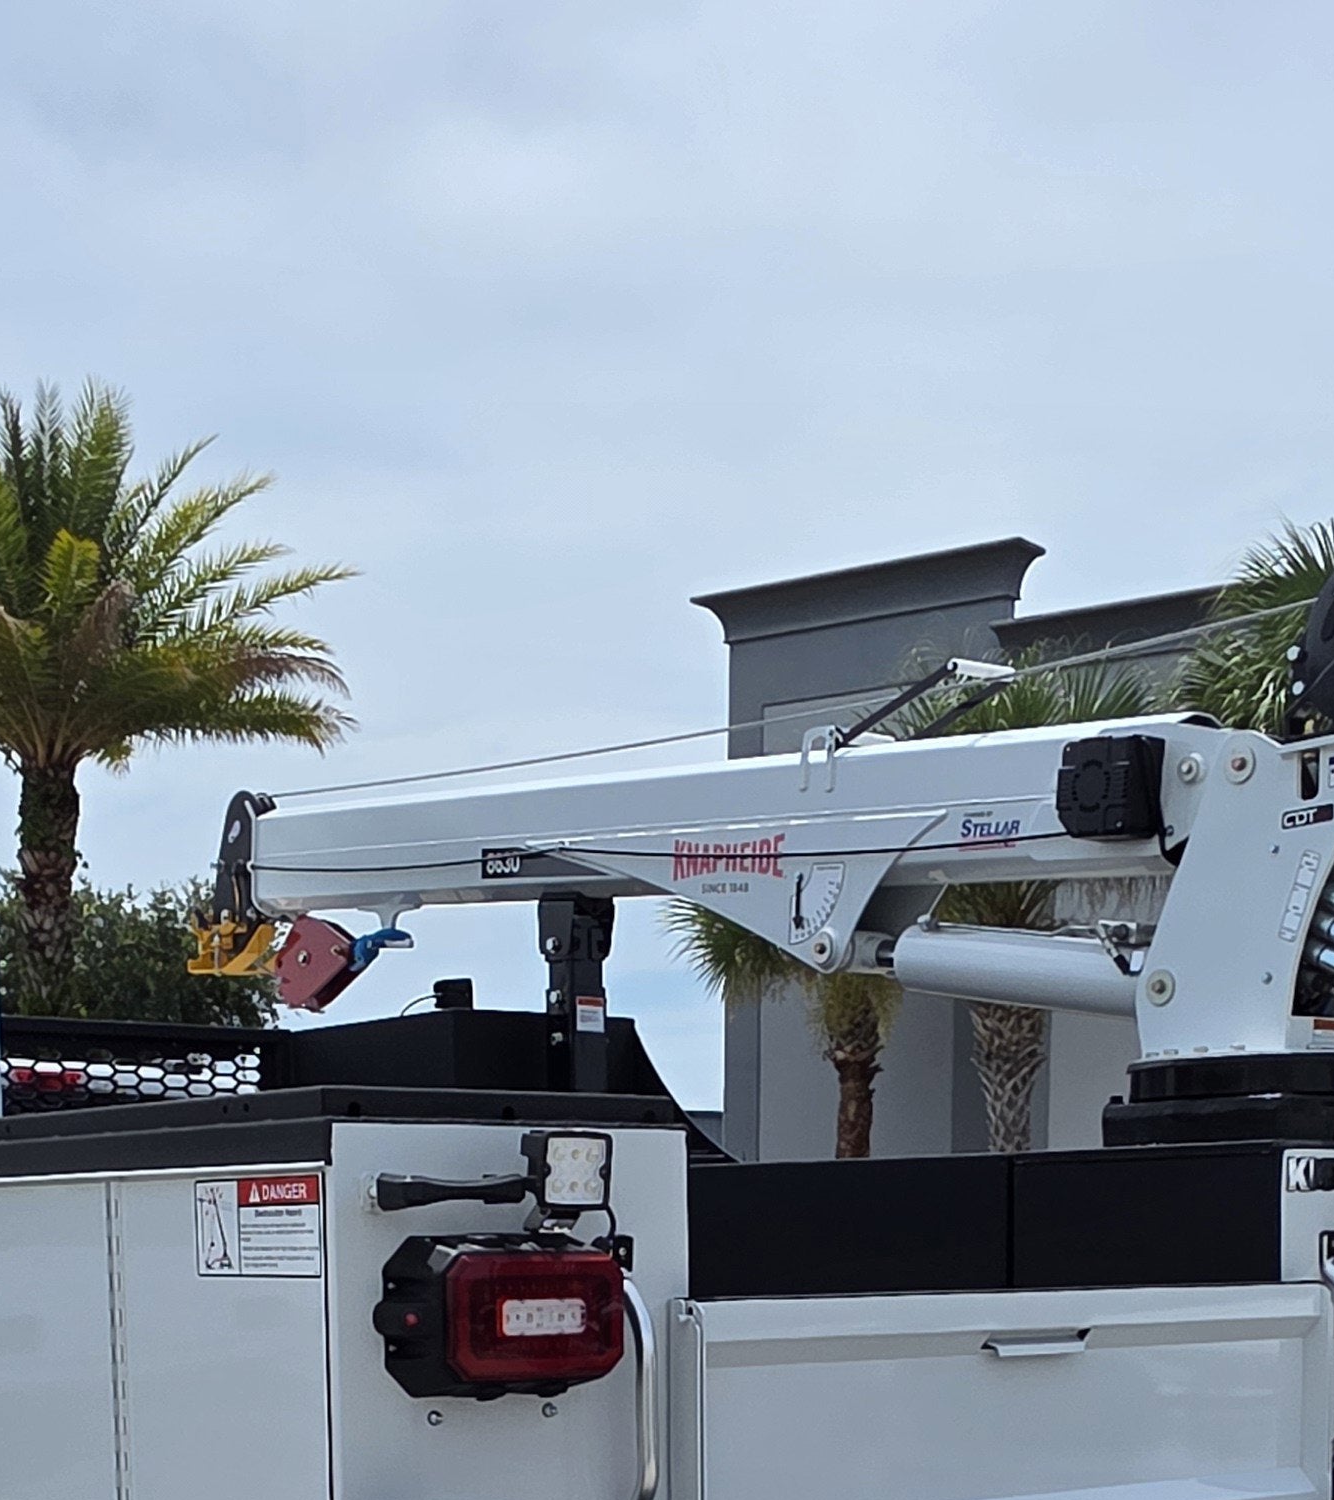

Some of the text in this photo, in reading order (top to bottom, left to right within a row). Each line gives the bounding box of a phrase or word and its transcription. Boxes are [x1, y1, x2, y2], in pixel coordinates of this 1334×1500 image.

[1283, 808, 1318, 827] CDT
[961, 819, 1021, 838] STELLAR
[673, 833, 785, 881] KNAPHEIDE
[262, 1183, 307, 1200] DANGER
